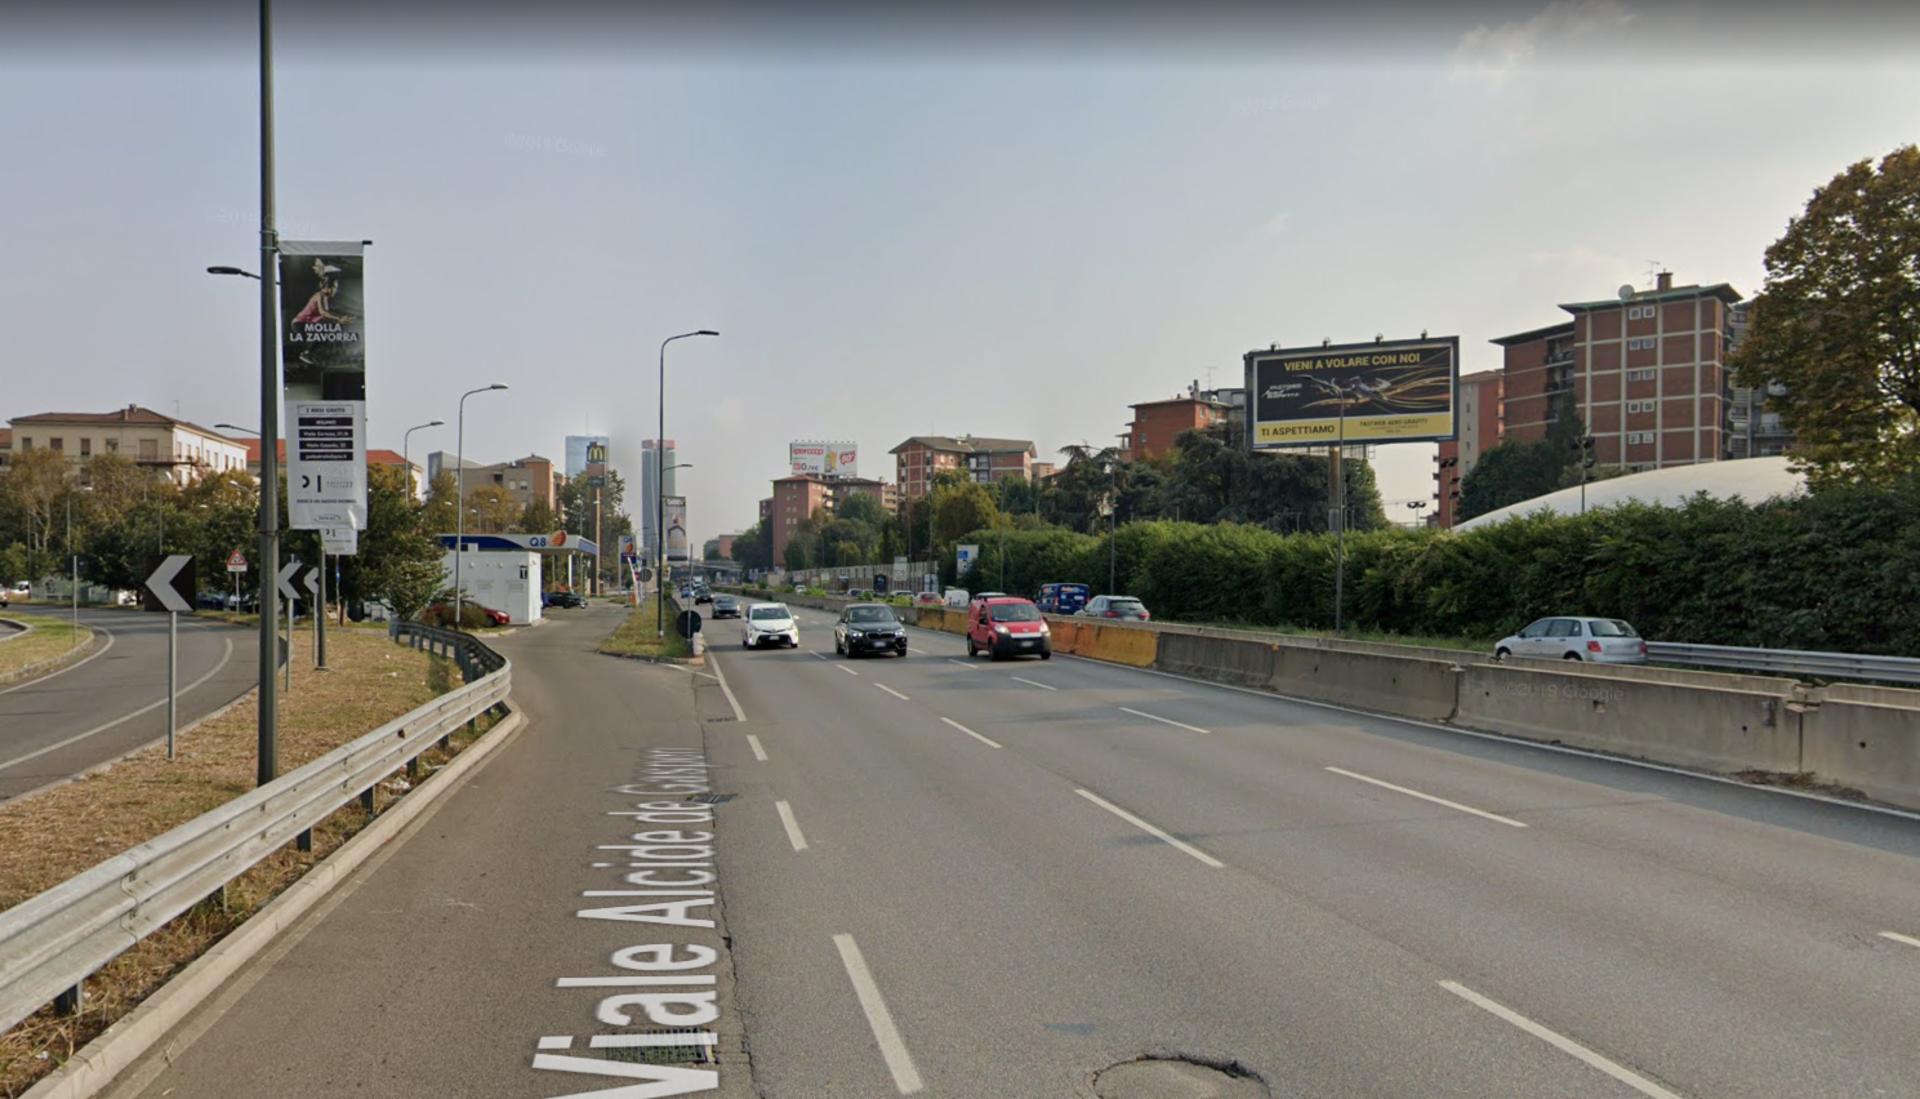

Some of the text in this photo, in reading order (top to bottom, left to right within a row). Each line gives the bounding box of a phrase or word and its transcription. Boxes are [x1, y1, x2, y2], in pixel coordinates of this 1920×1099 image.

[304, 323, 342, 332] MOLLA
[289, 333, 358, 342] LA ZAVORRA
[1284, 353, 1420, 372] VIENI A VOLARE CON NOI
[1261, 425, 1336, 437] TI ASPETTIAMO
[529, 537, 546, 547] Q8
